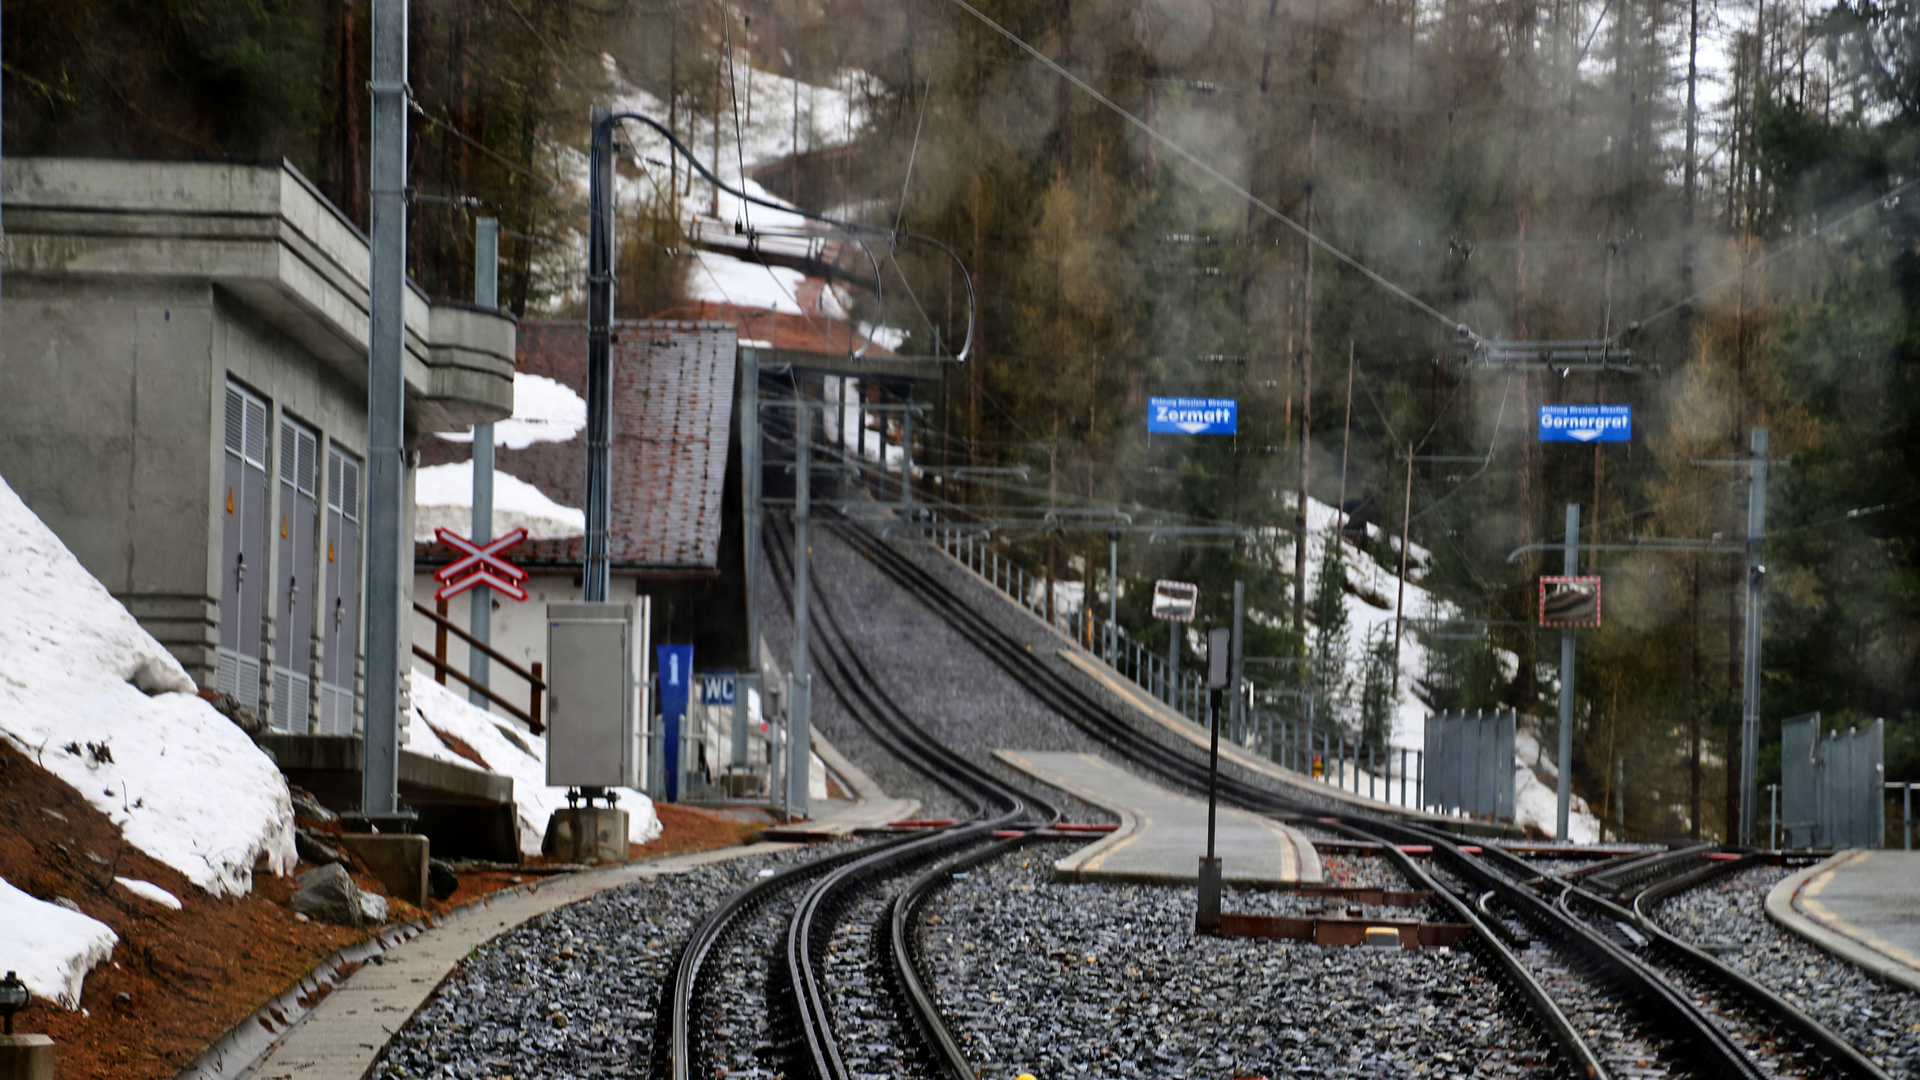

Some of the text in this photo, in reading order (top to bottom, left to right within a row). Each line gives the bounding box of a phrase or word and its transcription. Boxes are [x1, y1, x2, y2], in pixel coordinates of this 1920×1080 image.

[1156, 406, 1231, 424] Zermatt
[1541, 413, 1629, 432] Gornergrat
[704, 677, 734, 700] WC
